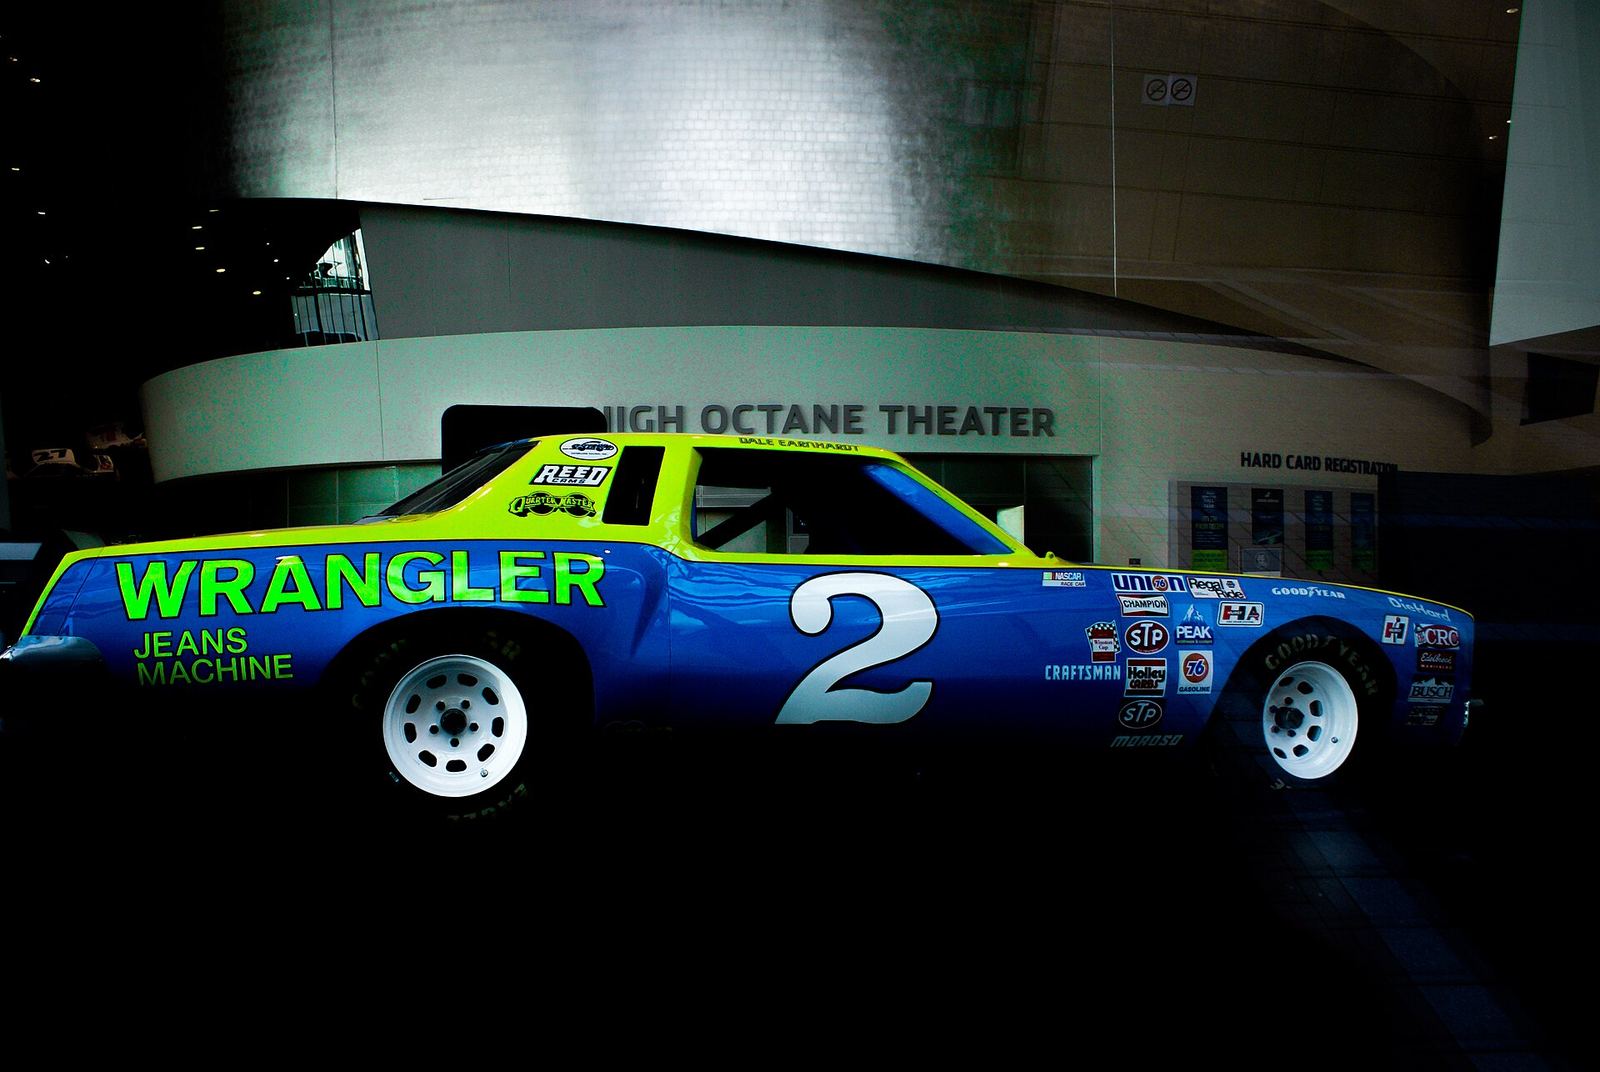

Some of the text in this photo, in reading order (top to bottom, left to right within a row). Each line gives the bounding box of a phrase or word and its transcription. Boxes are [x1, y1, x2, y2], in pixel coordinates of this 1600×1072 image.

[700, 404, 865, 434] OCTANE
[879, 404, 1056, 437] THEATER
[739, 437, 859, 452] DALE EARNHARDT
[1240, 452, 1281, 468] HARD
[1286, 455, 1321, 471] CARD
[533, 465, 609, 485] REED
[1055, 572, 1082, 580] NASCAR
[1188, 577, 1225, 592] Regal
[115, 550, 607, 621] WRANGLER
[1215, 588, 1245, 599] Ride
[1122, 599, 1167, 609] CHAMPION
[1130, 622, 1164, 646] STP
[1175, 625, 1212, 639] PEAK
[1425, 628, 1460, 647] CRC
[133, 627, 248, 660] JEANS
[774, 570, 939, 725] 2
[136, 654, 294, 687] MACHINE
[1045, 665, 1121, 681] CRAFTSMAN
[1127, 666, 1166, 682] Holley
[1186, 659, 1206, 677] 76
[1411, 685, 1453, 697] BUSCH
[1123, 702, 1157, 723] STP
[1110, 734, 1184, 748] MOROSO
